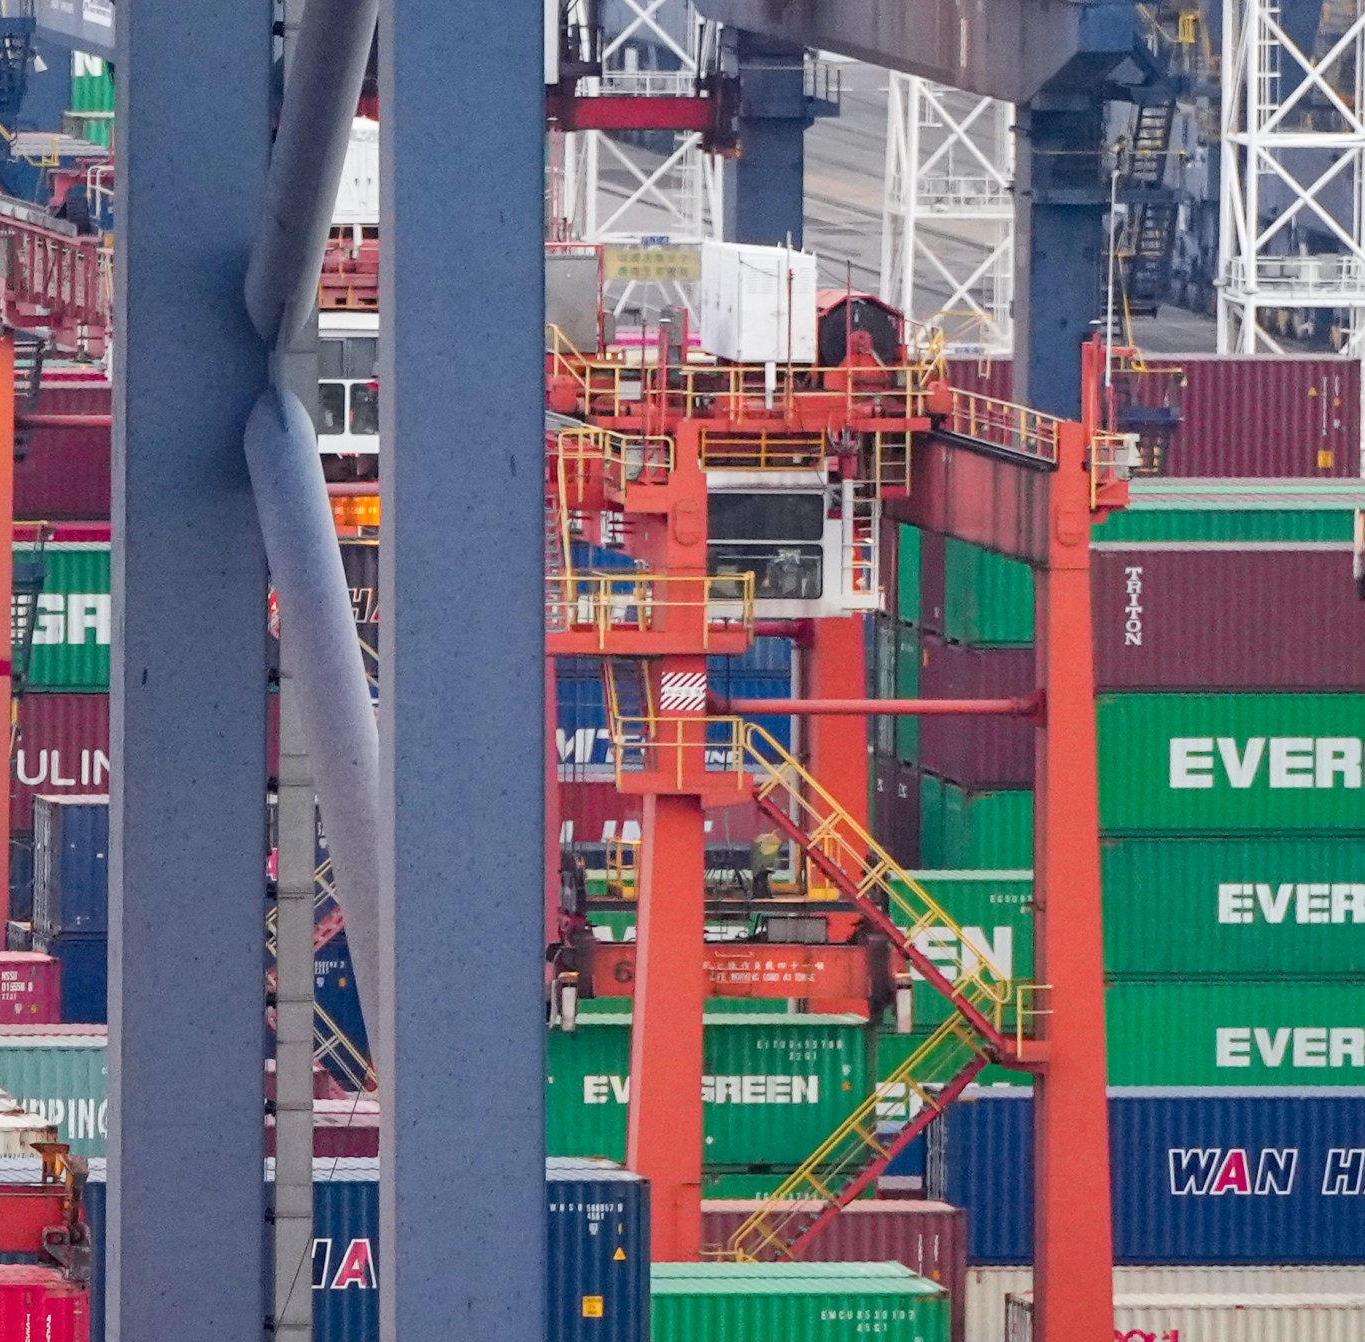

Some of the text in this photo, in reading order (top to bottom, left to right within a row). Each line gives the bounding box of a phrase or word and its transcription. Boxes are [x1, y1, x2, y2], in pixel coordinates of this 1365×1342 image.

[1125, 566, 1144, 646] TRITON
[1169, 736, 1363, 789] EVER
[1168, 1147, 1299, 1197] WAN
